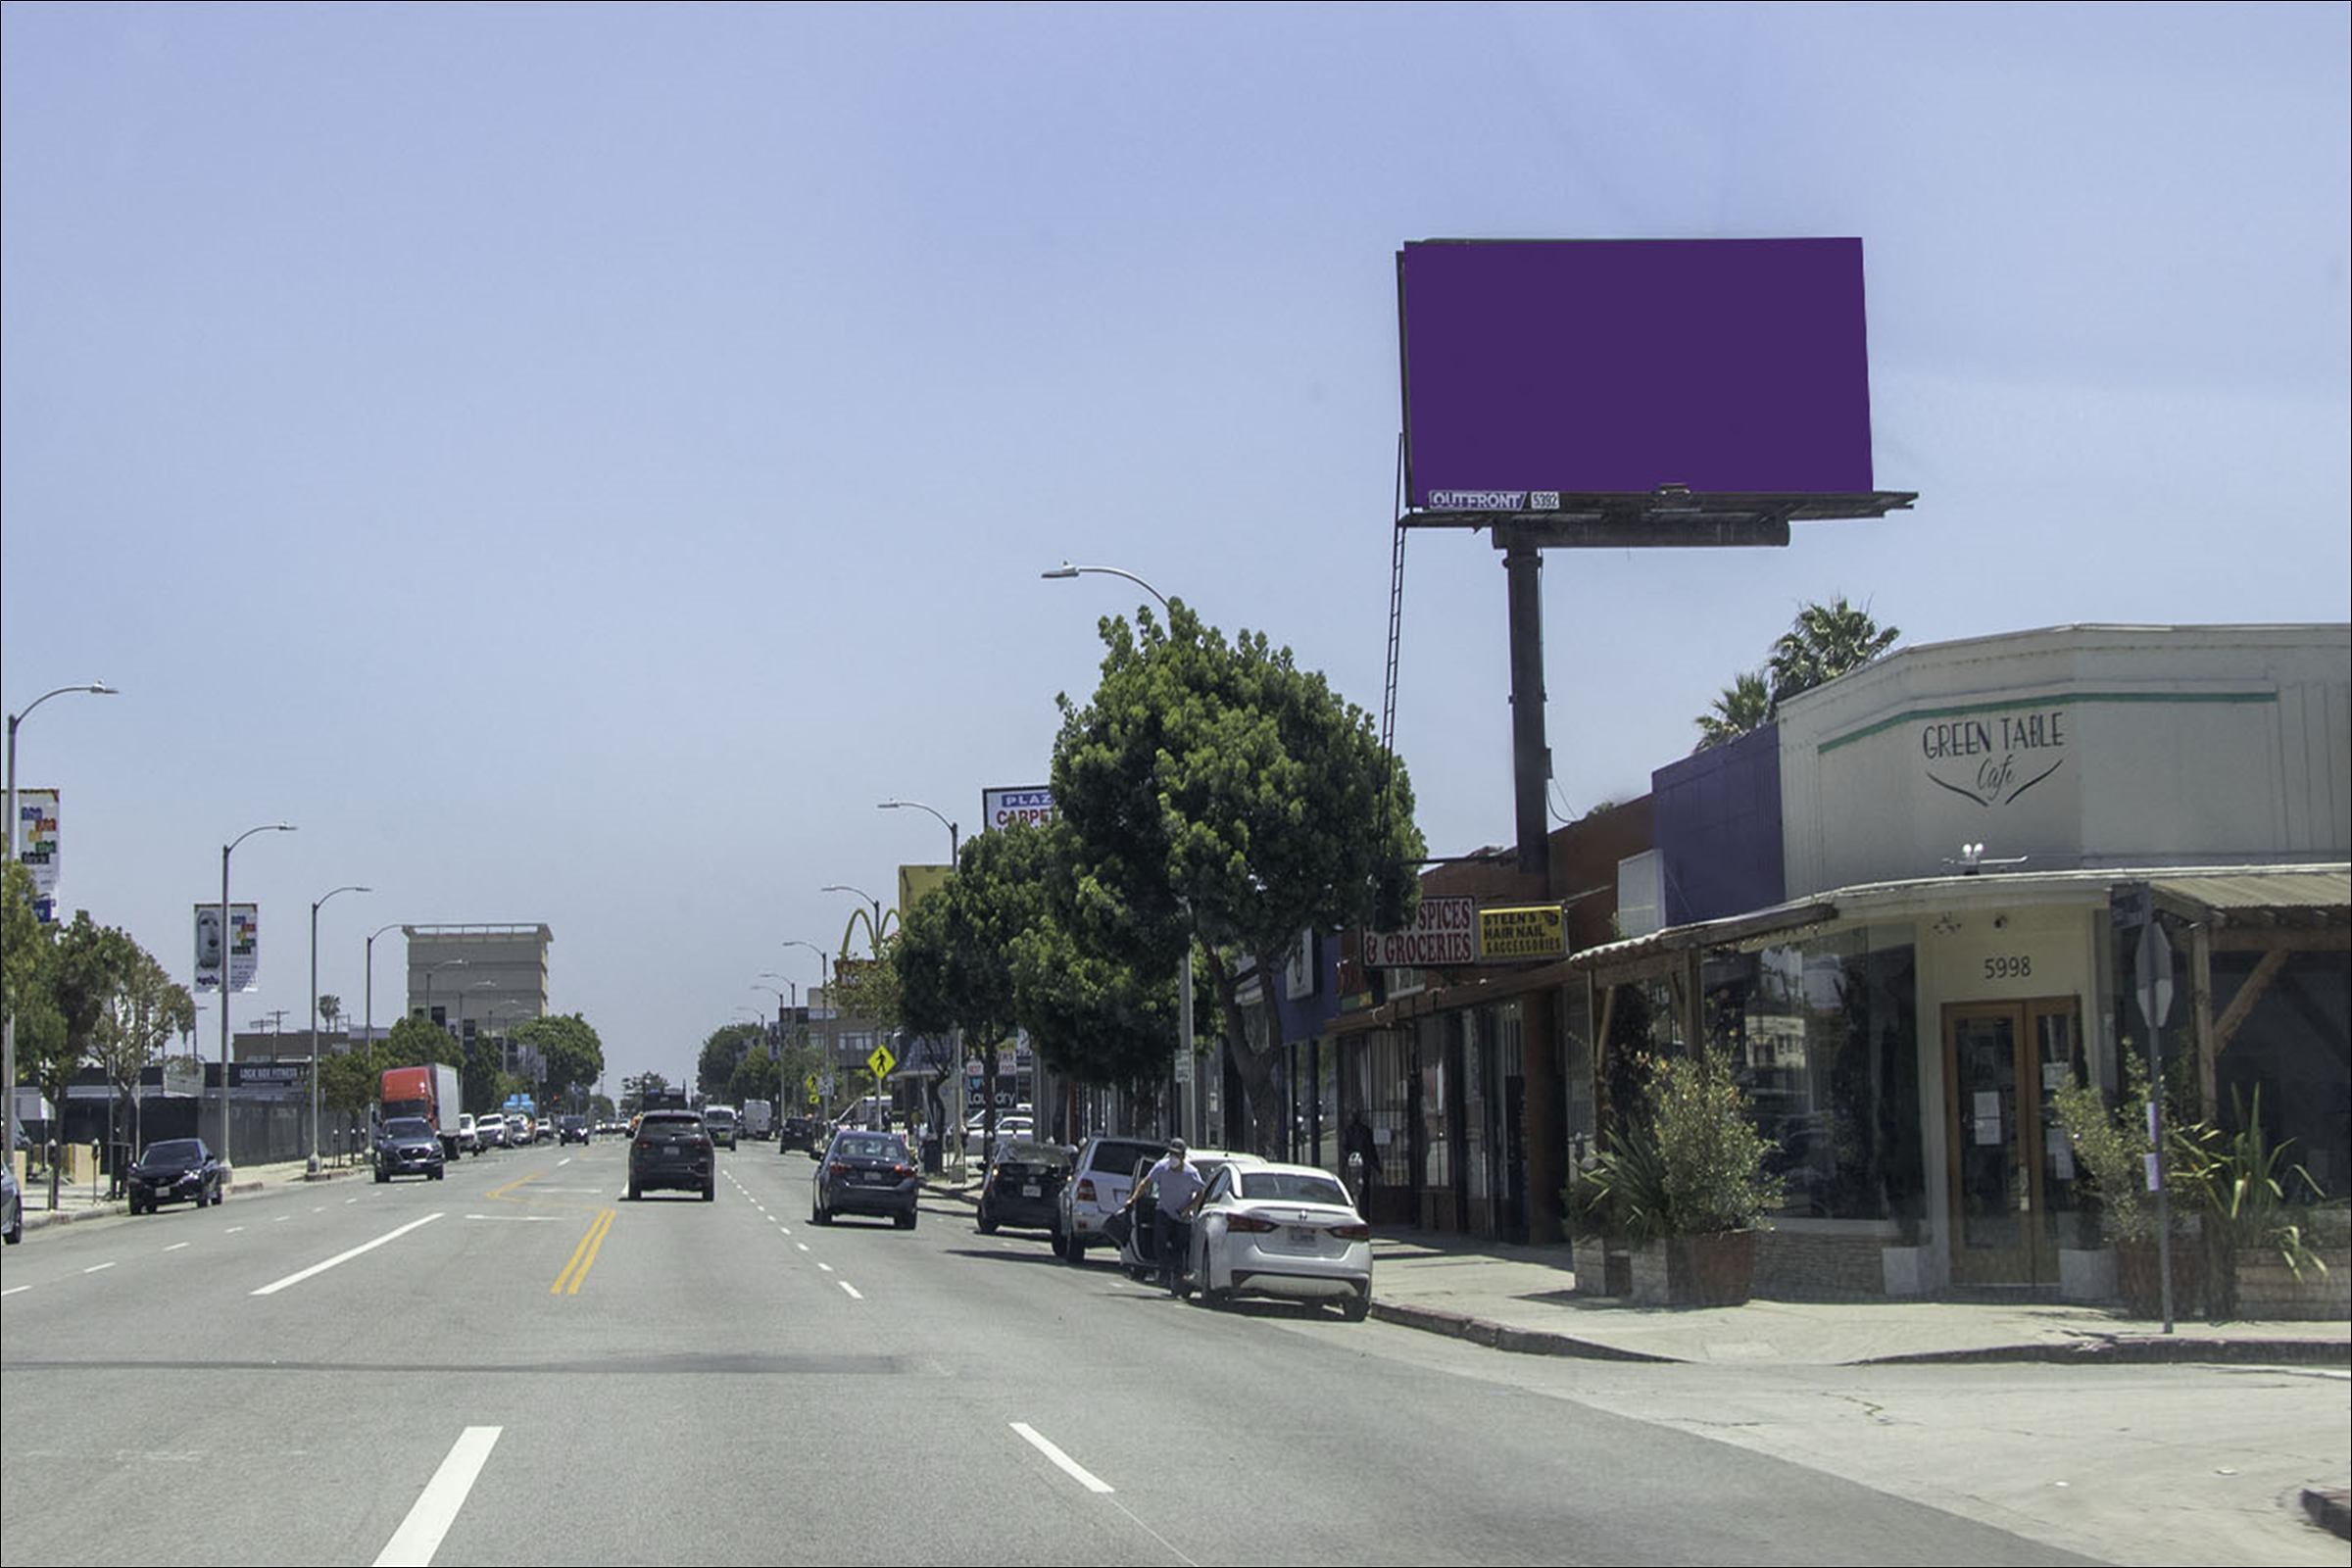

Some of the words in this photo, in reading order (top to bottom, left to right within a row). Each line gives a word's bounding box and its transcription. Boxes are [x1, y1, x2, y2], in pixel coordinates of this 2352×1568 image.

[1433, 492, 1521, 509] OUTFRONT
[1533, 493, 1558, 508] 5392
[1923, 719, 1991, 760] GREEN
[2001, 712, 2065, 751] TABLE
[1005, 794, 1054, 806] PLAZ
[997, 808, 1050, 825] CARPE
[1417, 900, 1470, 930] SPICES
[1484, 925, 1513, 939] HAIR
[1516, 924, 1545, 938] NAIL
[1365, 935, 1378, 964] &
[1384, 932, 1472, 964] GROCERIES
[1984, 956, 2032, 979] 5998
